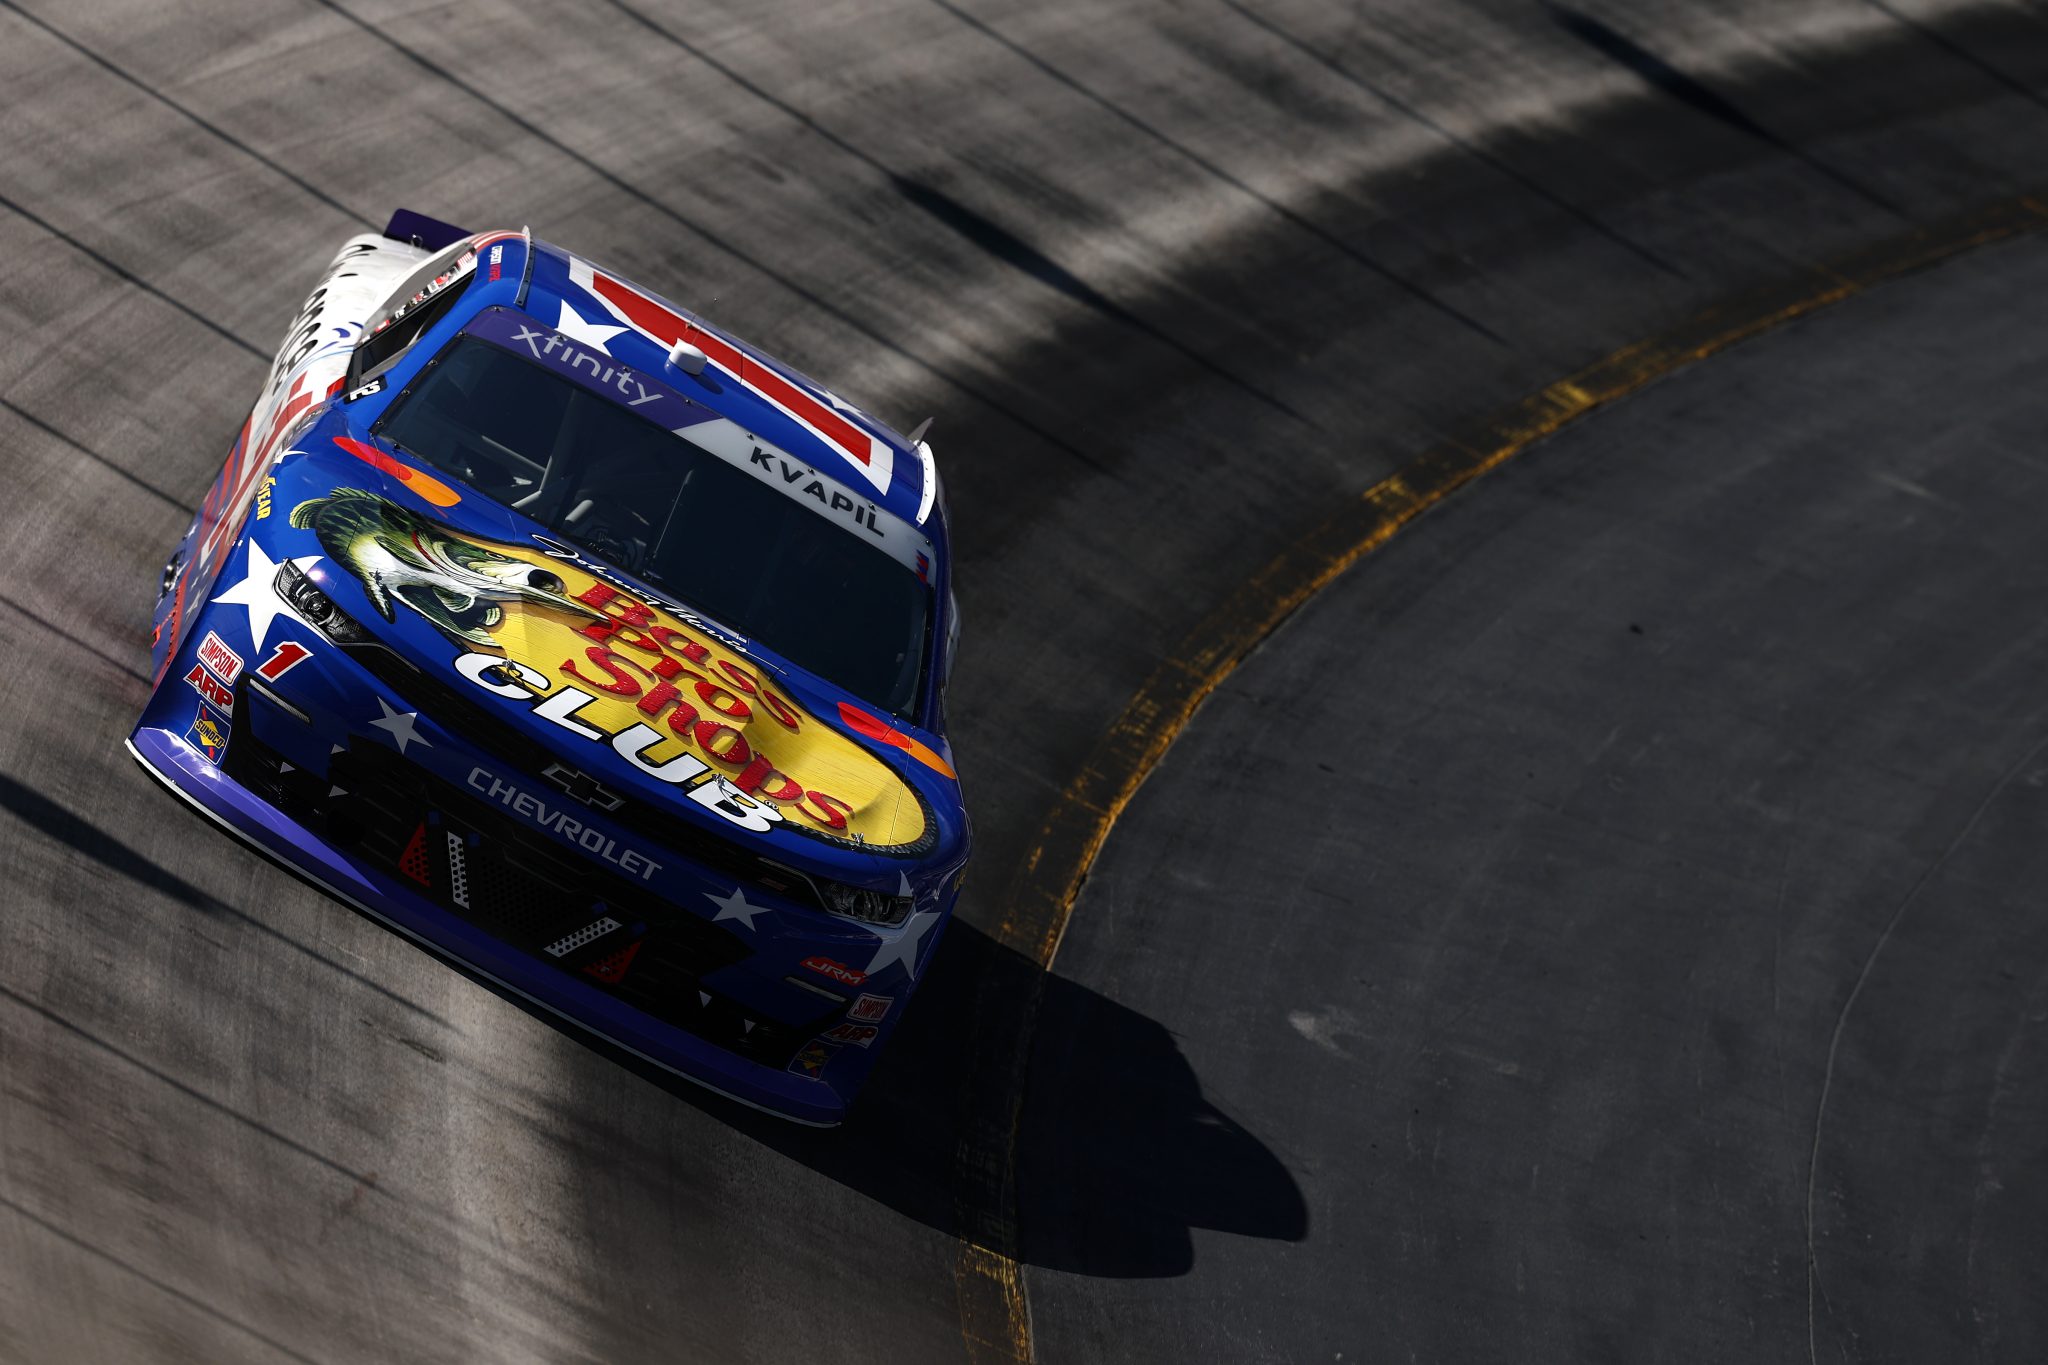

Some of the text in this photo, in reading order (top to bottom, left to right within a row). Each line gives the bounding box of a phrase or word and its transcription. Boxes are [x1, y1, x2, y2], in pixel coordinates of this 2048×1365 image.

[749, 446, 886, 538] KVAPIL
[186, 664, 233, 707] ARP
[200, 636, 239, 679] SIMPSON
[256, 641, 314, 683] 1
[568, 580, 801, 730] Bass
[574, 617, 753, 722] Pro
[195, 721, 225, 748] SUNOCO
[454, 651, 784, 833] CLUB
[559, 647, 850, 831] Shops
[467, 766, 663, 882] CHEVROLET
[807, 960, 862, 985] JRM
